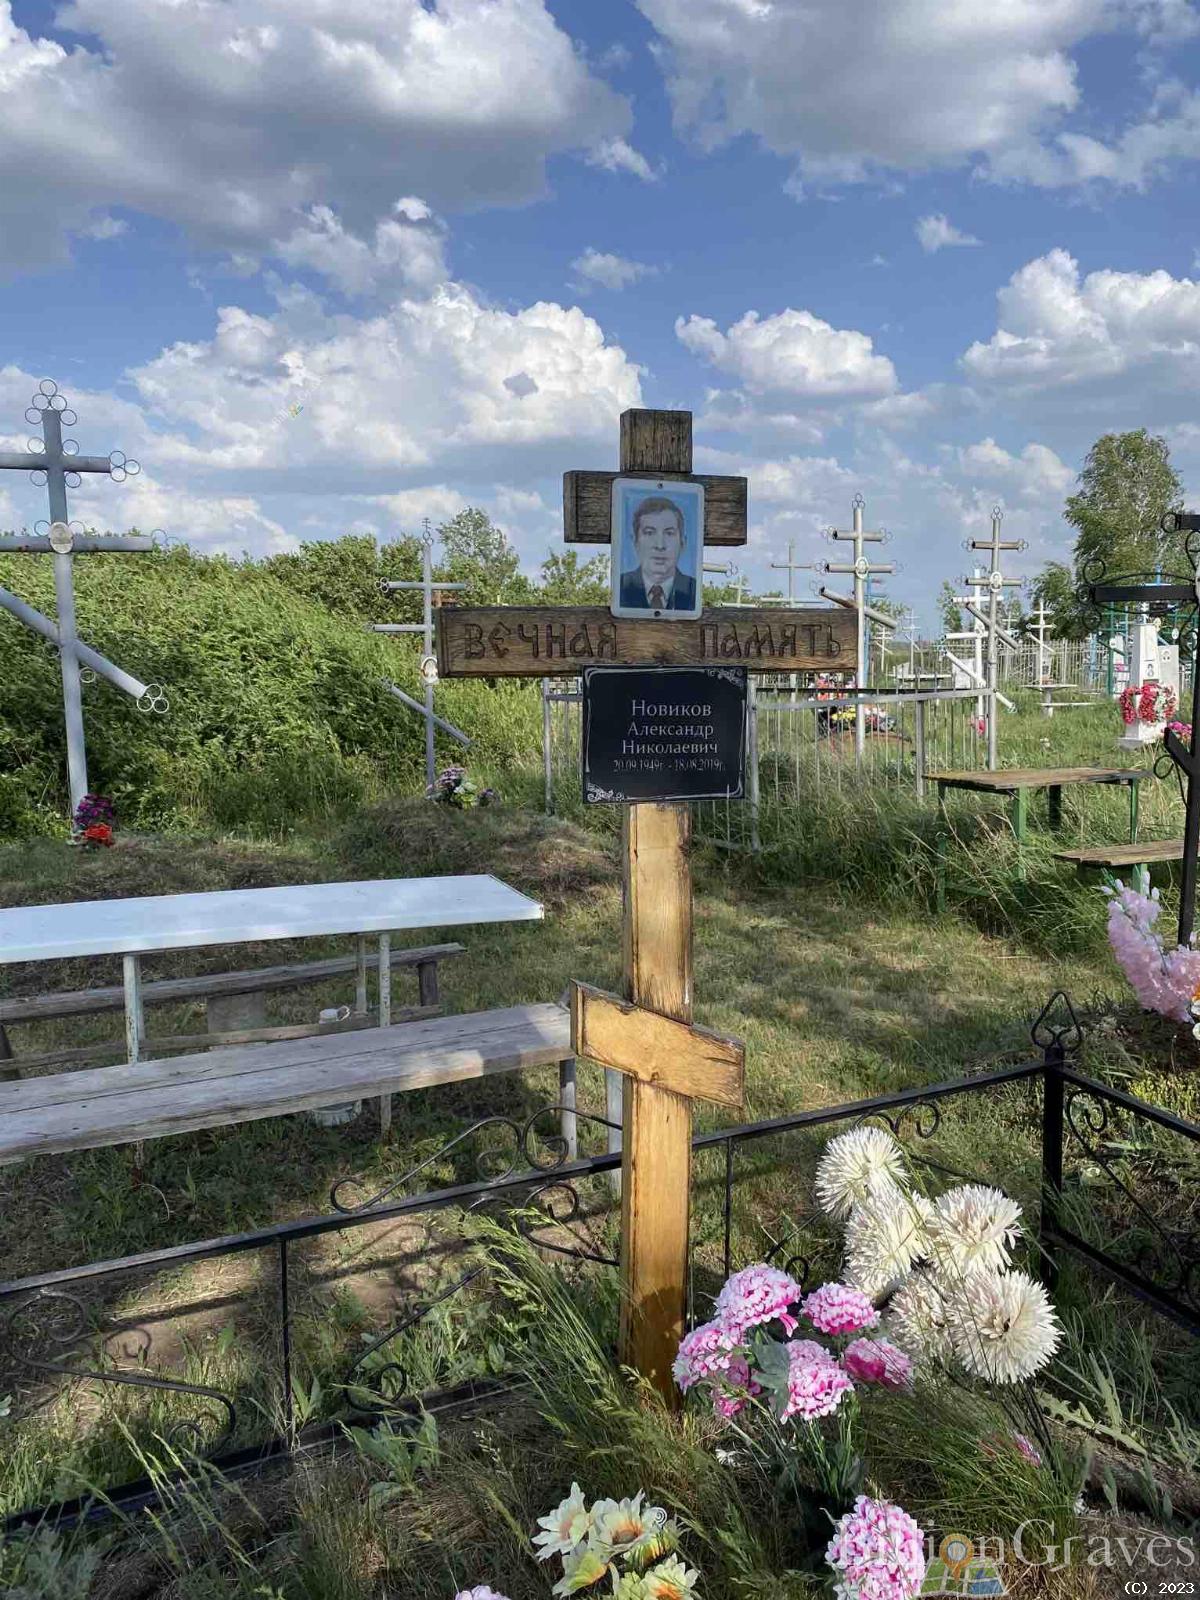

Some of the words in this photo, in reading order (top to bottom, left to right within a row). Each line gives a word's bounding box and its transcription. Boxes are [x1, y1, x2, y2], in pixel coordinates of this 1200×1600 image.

[631, 699, 712, 716] Новиков
[627, 721, 714, 739] Александр
[622, 739, 718, 754] Николаевич
